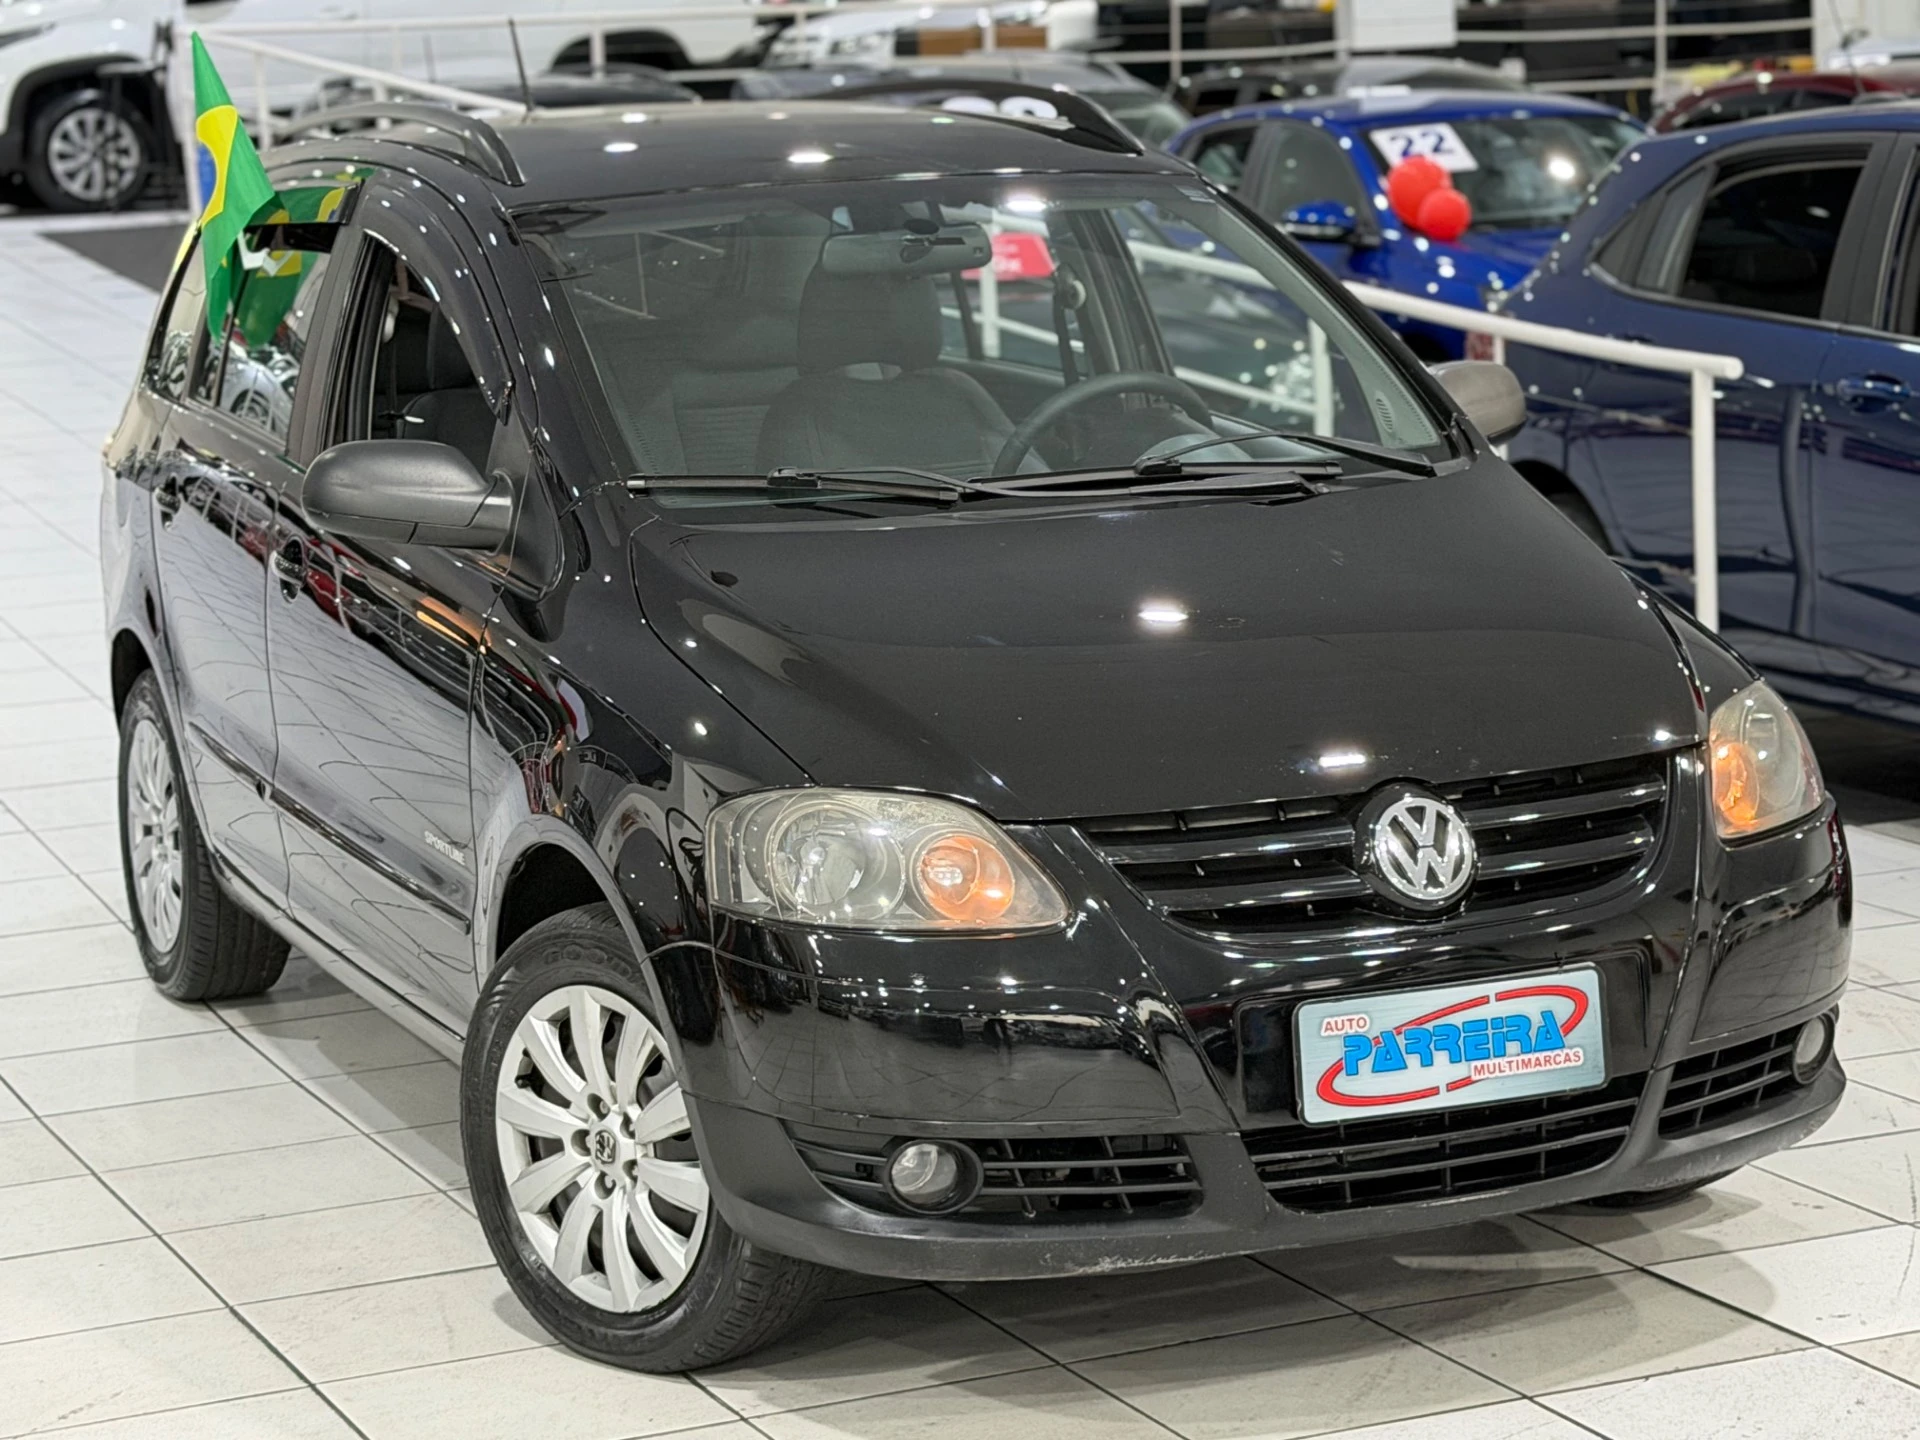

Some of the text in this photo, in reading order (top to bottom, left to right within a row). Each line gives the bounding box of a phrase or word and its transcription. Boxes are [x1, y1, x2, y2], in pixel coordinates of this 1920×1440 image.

[1389, 131, 1455, 157] 22
[1323, 1016, 1367, 1034] AUTO
[1343, 1010, 1565, 1076] PARREIRA
[1473, 1050, 1582, 1077] MULTIMARCAS
